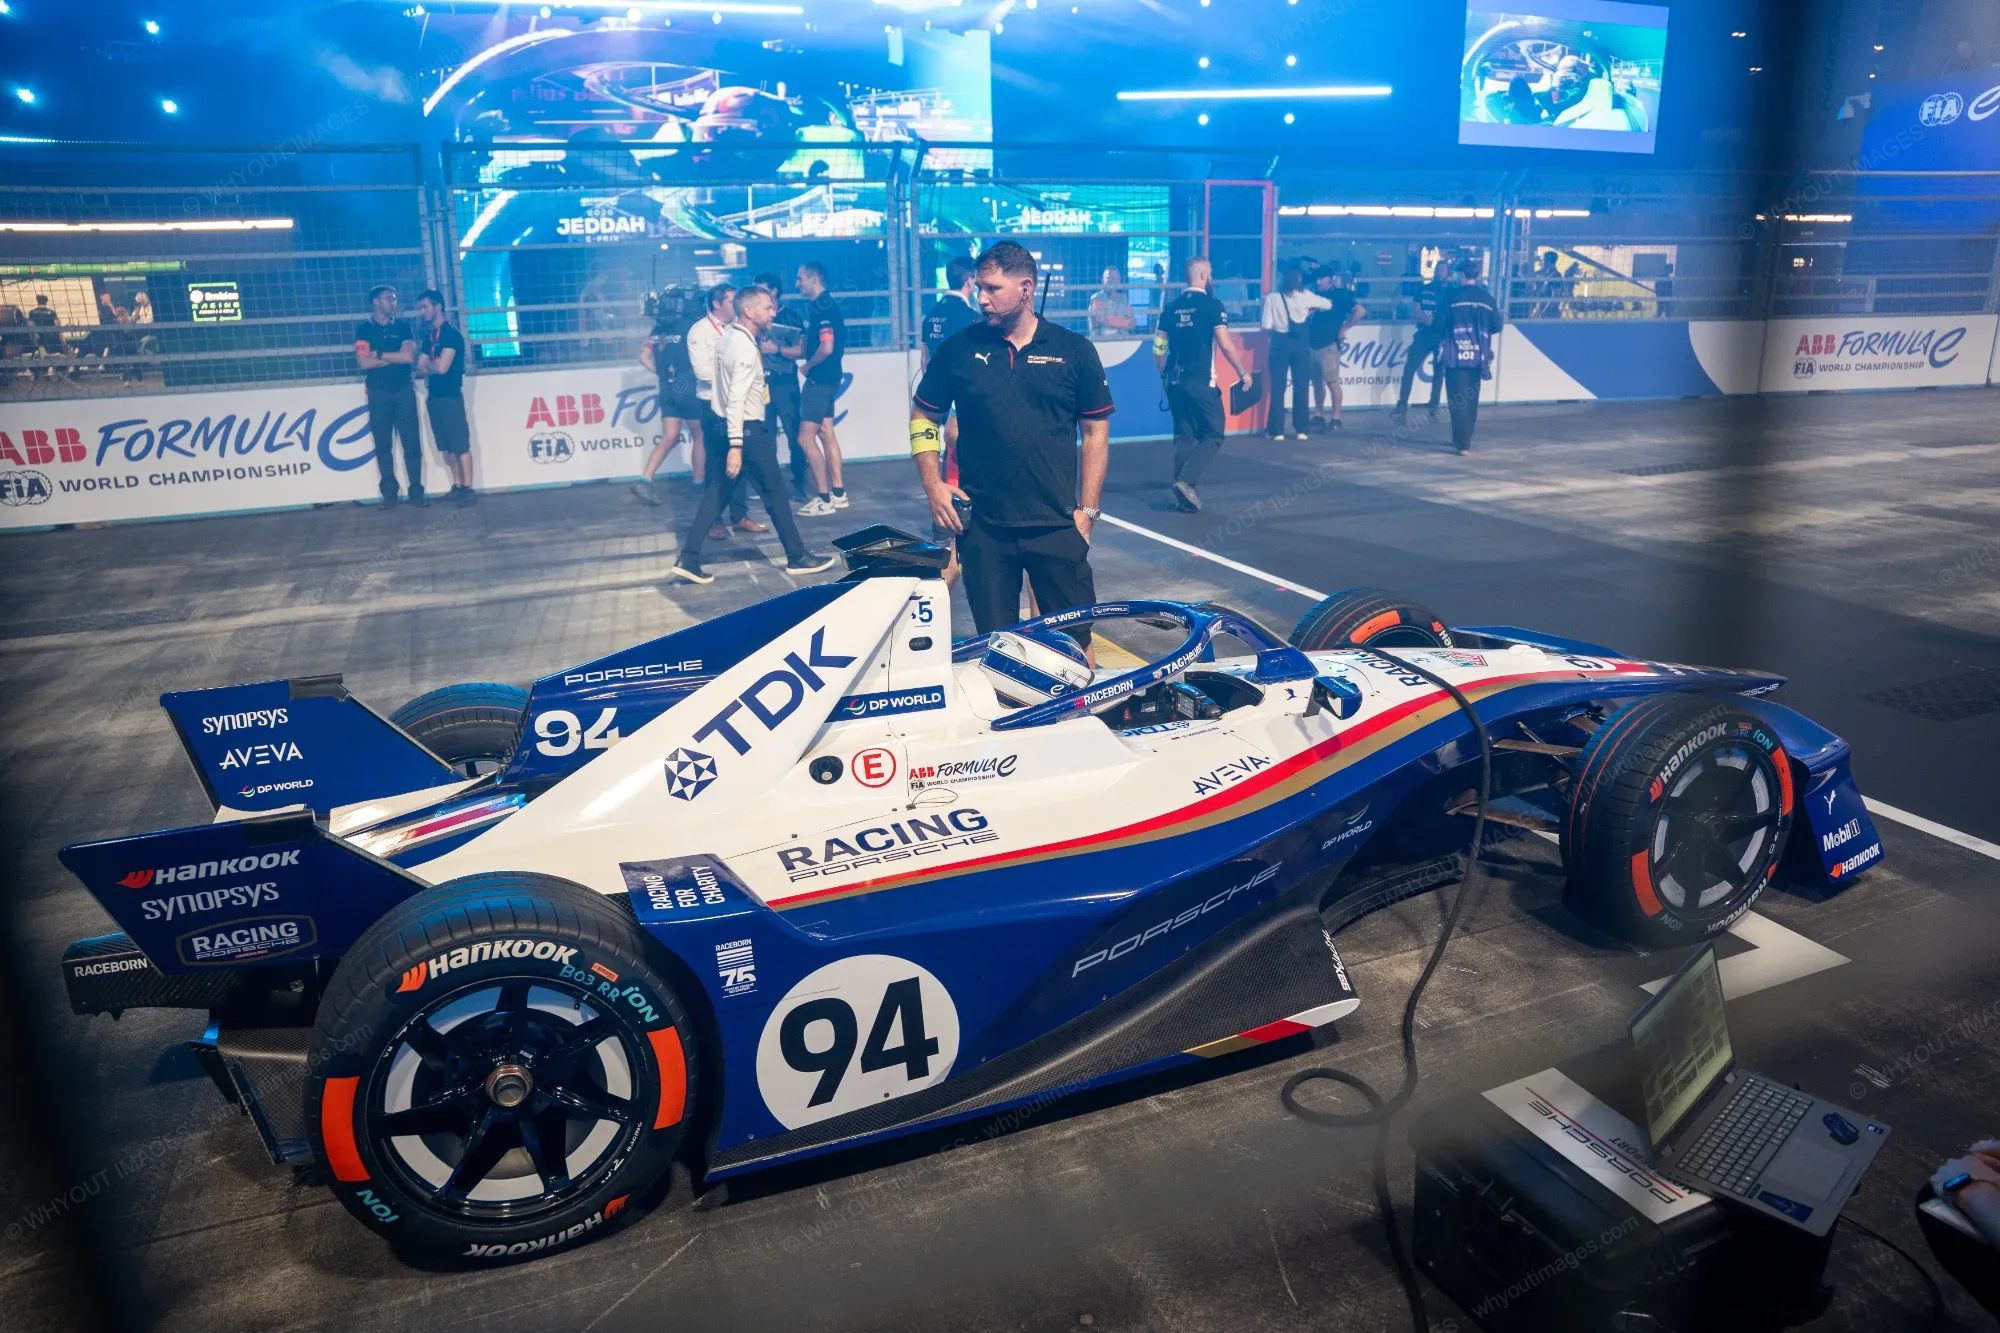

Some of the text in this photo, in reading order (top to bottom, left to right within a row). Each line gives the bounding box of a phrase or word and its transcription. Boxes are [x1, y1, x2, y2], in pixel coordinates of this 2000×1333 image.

[556, 216, 646, 235] JEDDAH
[1794, 334, 1836, 356] ABB
[1836, 329, 1936, 358] FORMULA
[1819, 363, 1851, 373] WORLD
[1854, 361, 1925, 371] CHAMPIONSHIP
[525, 393, 605, 429] ABB
[0, 427, 88, 466] ABB
[95, 408, 317, 467] FORMULA
[580, 437, 645, 453] WORLD
[59, 474, 140, 493] WORLD
[148, 462, 312, 487] CHAMPIONSHIP
[564, 660, 703, 686] PORSCHE
[692, 624, 858, 757] TDK
[869, 692, 942, 711] DP WORLD
[1084, 679, 1134, 706] RACEBORN
[202, 708, 289, 735] SYNOPSYS
[534, 706, 630, 756] 94
[219, 742, 303, 769] AVEVA
[863, 753, 885, 780] E
[909, 766, 935, 780] ABB
[936, 757, 998, 778] FORMULA
[257, 779, 314, 795] DP WORLD
[950, 774, 996, 784] CHAMPIONSHIP
[1192, 755, 1271, 796] AVEVA
[776, 808, 989, 873] RACING
[1321, 820, 1373, 851] DP WORLD
[1823, 822, 1852, 852] Mobil
[787, 830, 1000, 882] PORSCHE
[643, 874, 674, 910] RACING
[674, 887, 700, 909] FOR
[690, 866, 726, 905] CHARITY
[141, 882, 280, 921] SYNOPSYS
[1072, 860, 1283, 978] PORSCHE
[191, 921, 299, 953] RACING
[195, 936, 301, 960] PORSCHE
[715, 938, 752, 952] RACEBORN
[73, 958, 148, 977] RACEBORN
[719, 964, 757, 987] 75
[779, 976, 941, 1108] 94
[1527, 1099, 1677, 1205] PORSCHE
